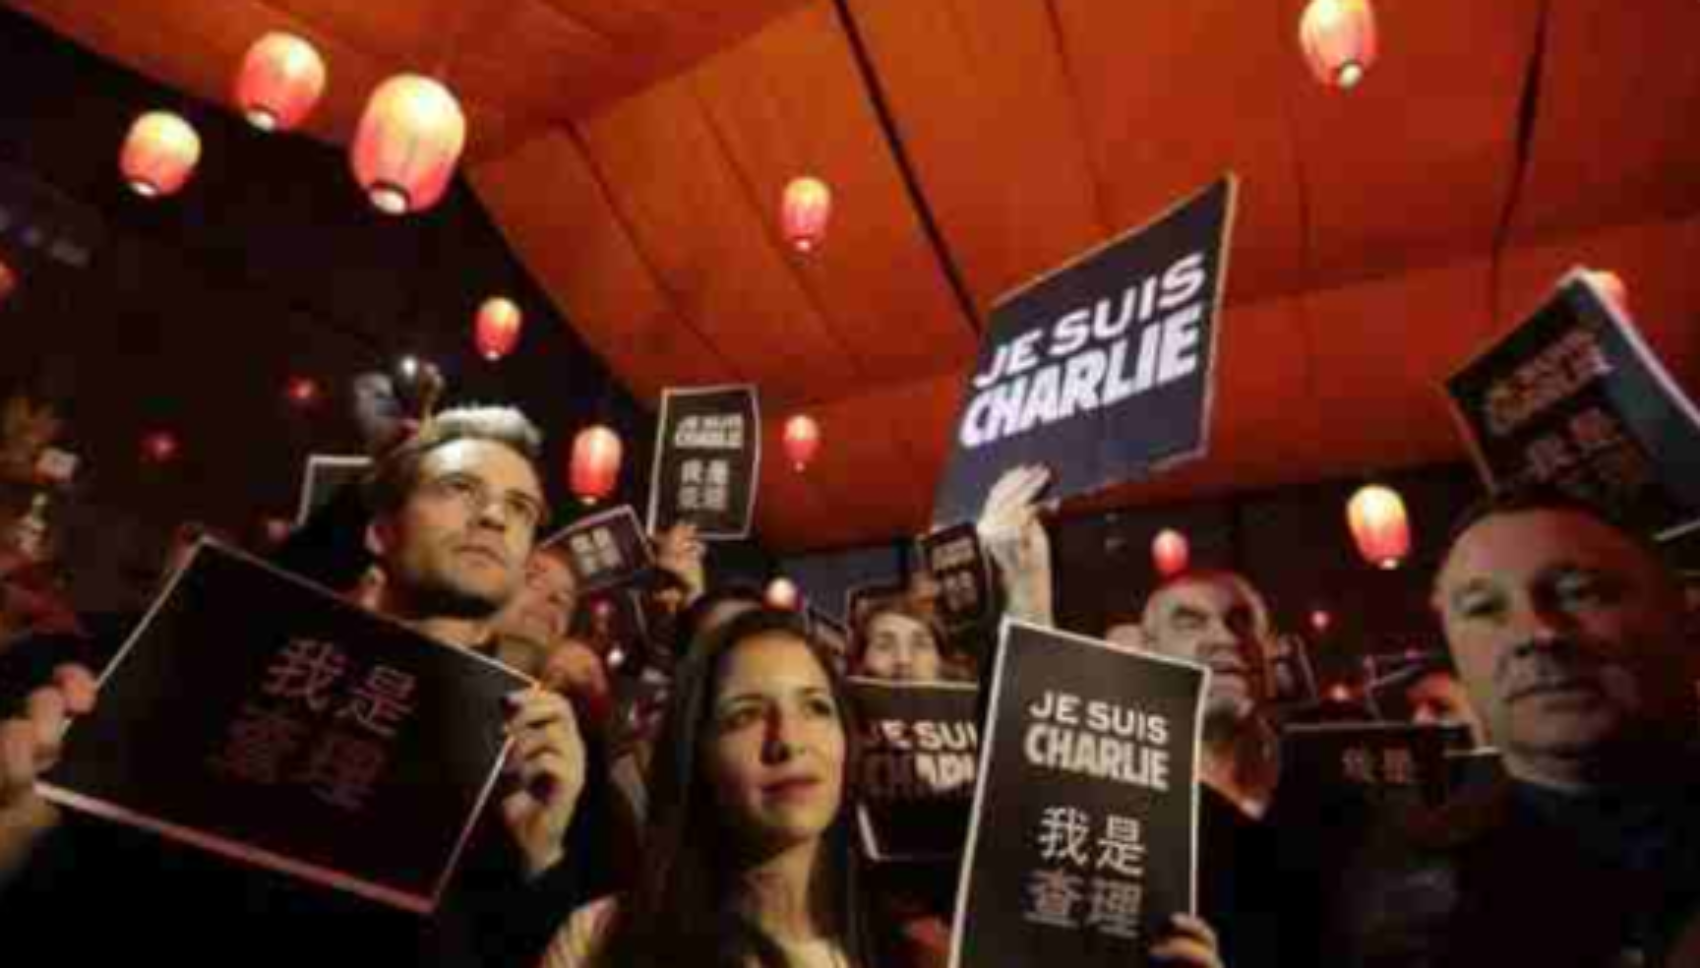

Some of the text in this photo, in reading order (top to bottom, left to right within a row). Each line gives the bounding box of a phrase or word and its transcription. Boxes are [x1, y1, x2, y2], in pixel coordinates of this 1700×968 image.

[973, 252, 1206, 389] JE SUIS
[959, 303, 1203, 450] CHARLIE
[260, 637, 417, 738] 我是
[1028, 690, 1169, 746] JE SUIS
[1023, 722, 1170, 792] CHARLIE
[1038, 804, 1147, 878] 我是
[1022, 868, 1144, 938] 查理
